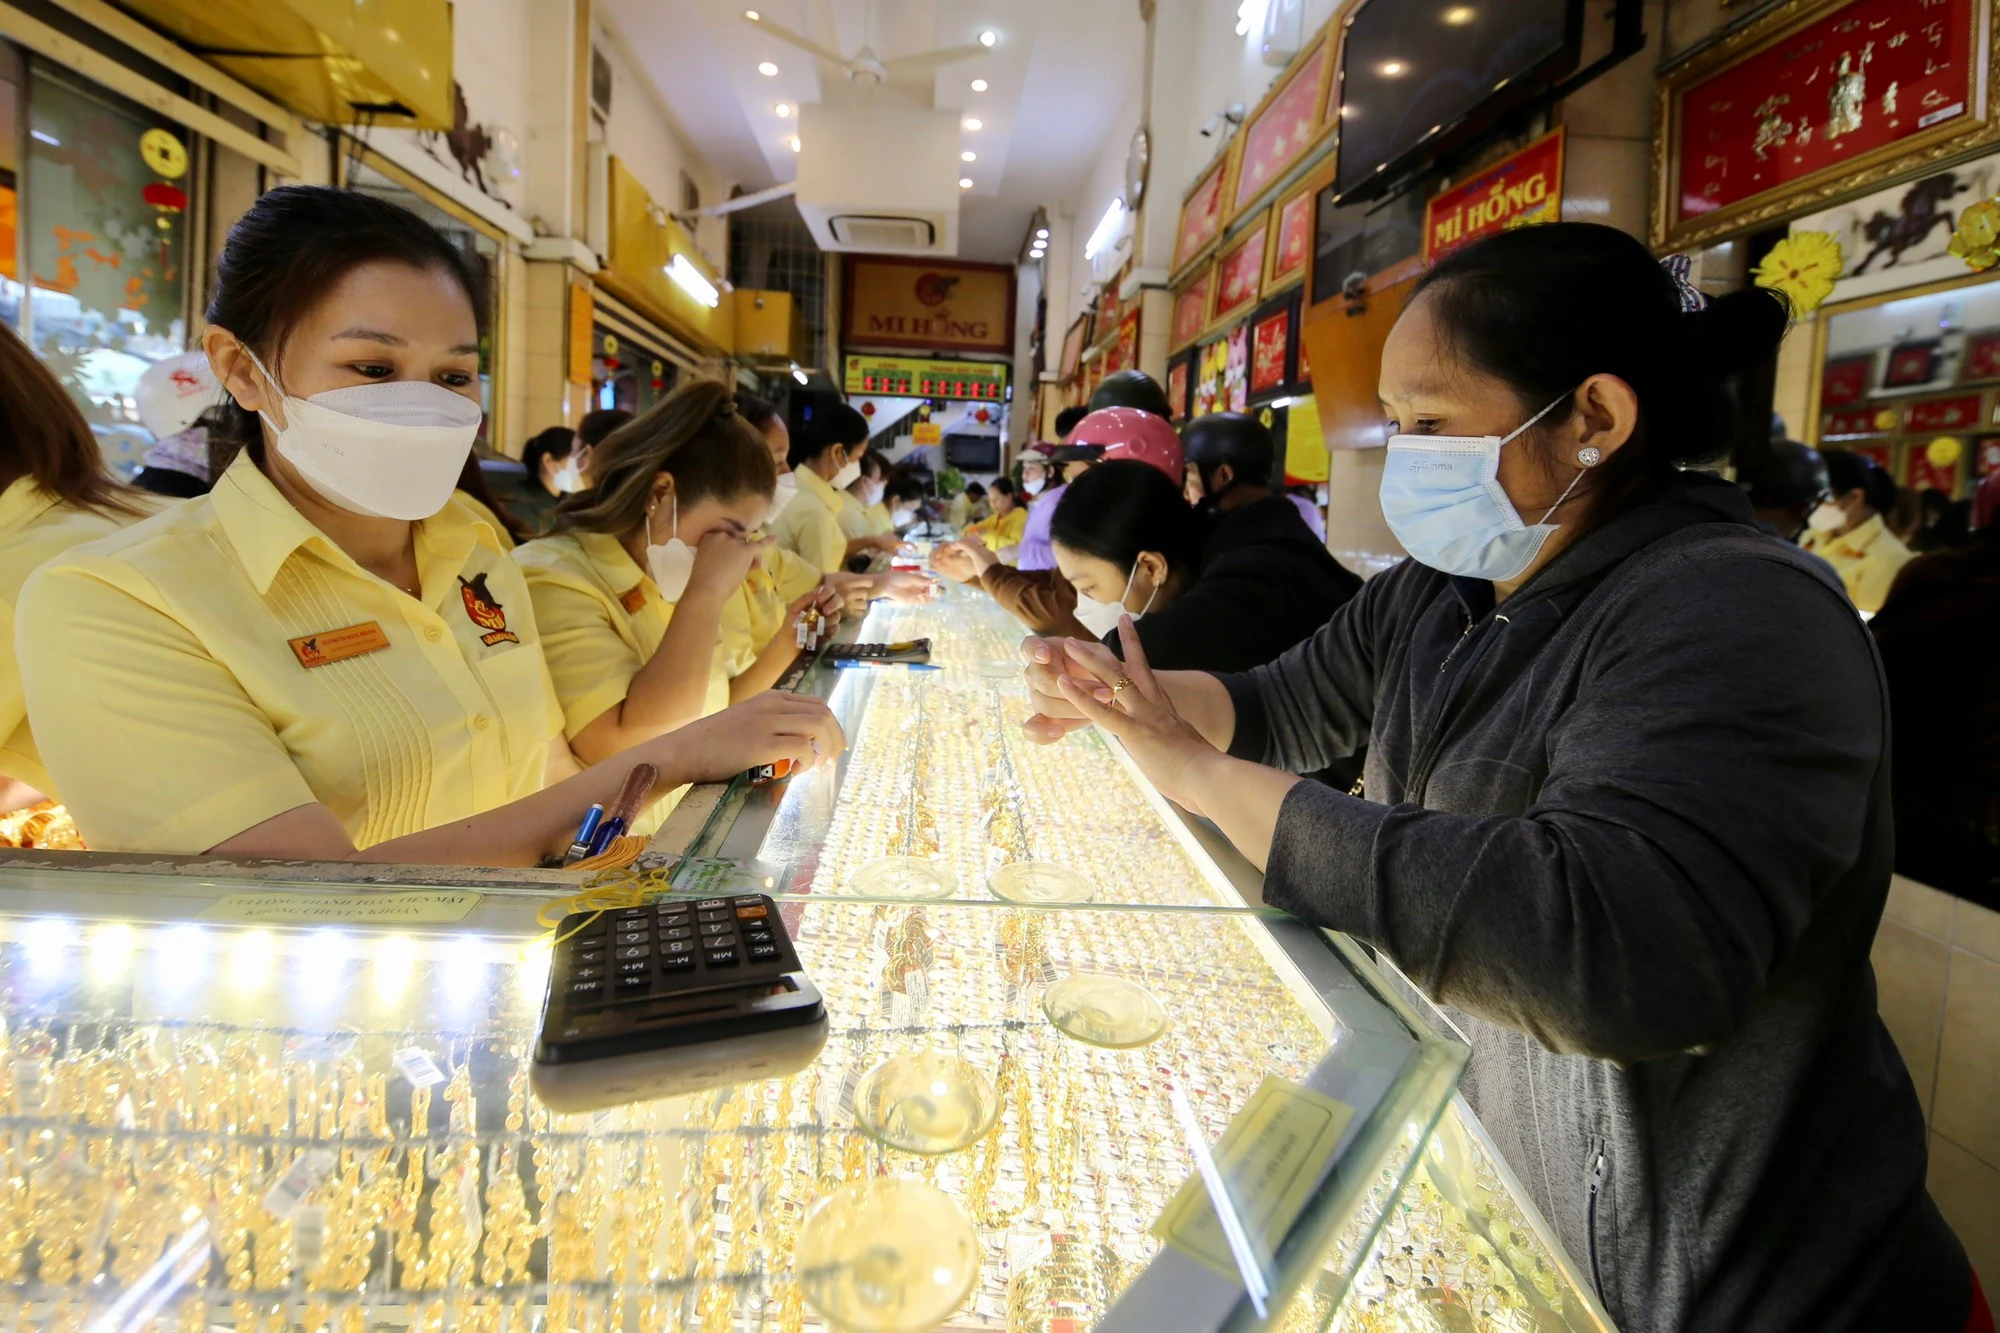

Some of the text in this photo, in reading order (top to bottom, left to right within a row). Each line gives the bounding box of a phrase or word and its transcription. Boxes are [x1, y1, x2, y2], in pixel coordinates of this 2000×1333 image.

[1422, 460, 1453, 471] Gunma
[626, 920, 638, 929] 3
[667, 916, 679, 925] 2
[668, 929, 680, 937] 5
[709, 924, 721, 933] 4
[626, 933, 639, 943] 6
[713, 937, 725, 946] 7
[670, 942, 683, 952] 8
[753, 945, 774, 954] MC
[626, 947, 639, 957] 9
[712, 951, 732, 960] MR
[622, 962, 644, 971] M+
